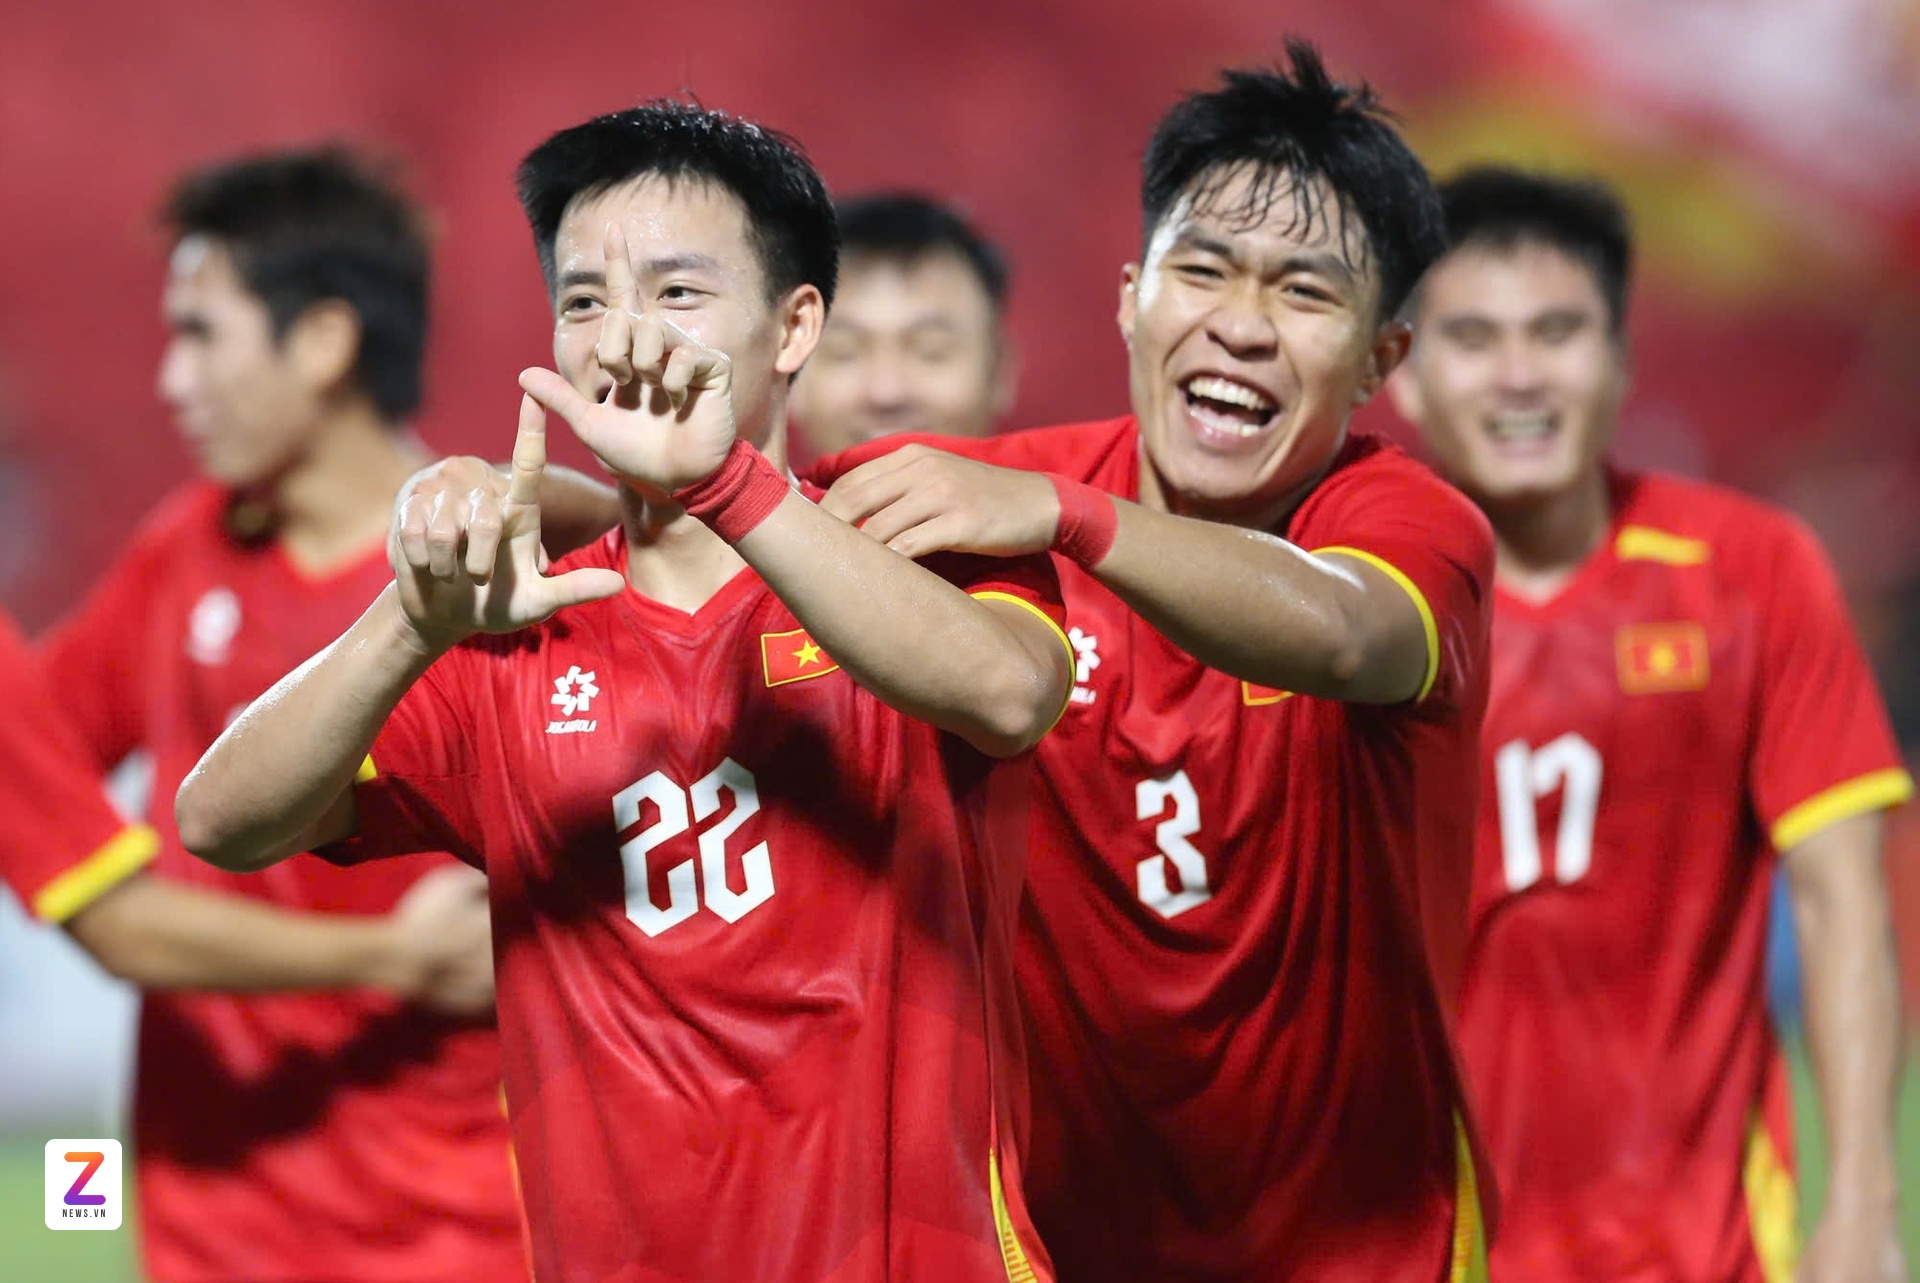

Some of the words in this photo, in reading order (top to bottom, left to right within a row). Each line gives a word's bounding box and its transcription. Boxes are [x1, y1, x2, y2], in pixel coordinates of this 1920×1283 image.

[612, 756, 776, 938] 22
[1135, 769, 1212, 919] 3
[1496, 733, 1603, 891] 17
